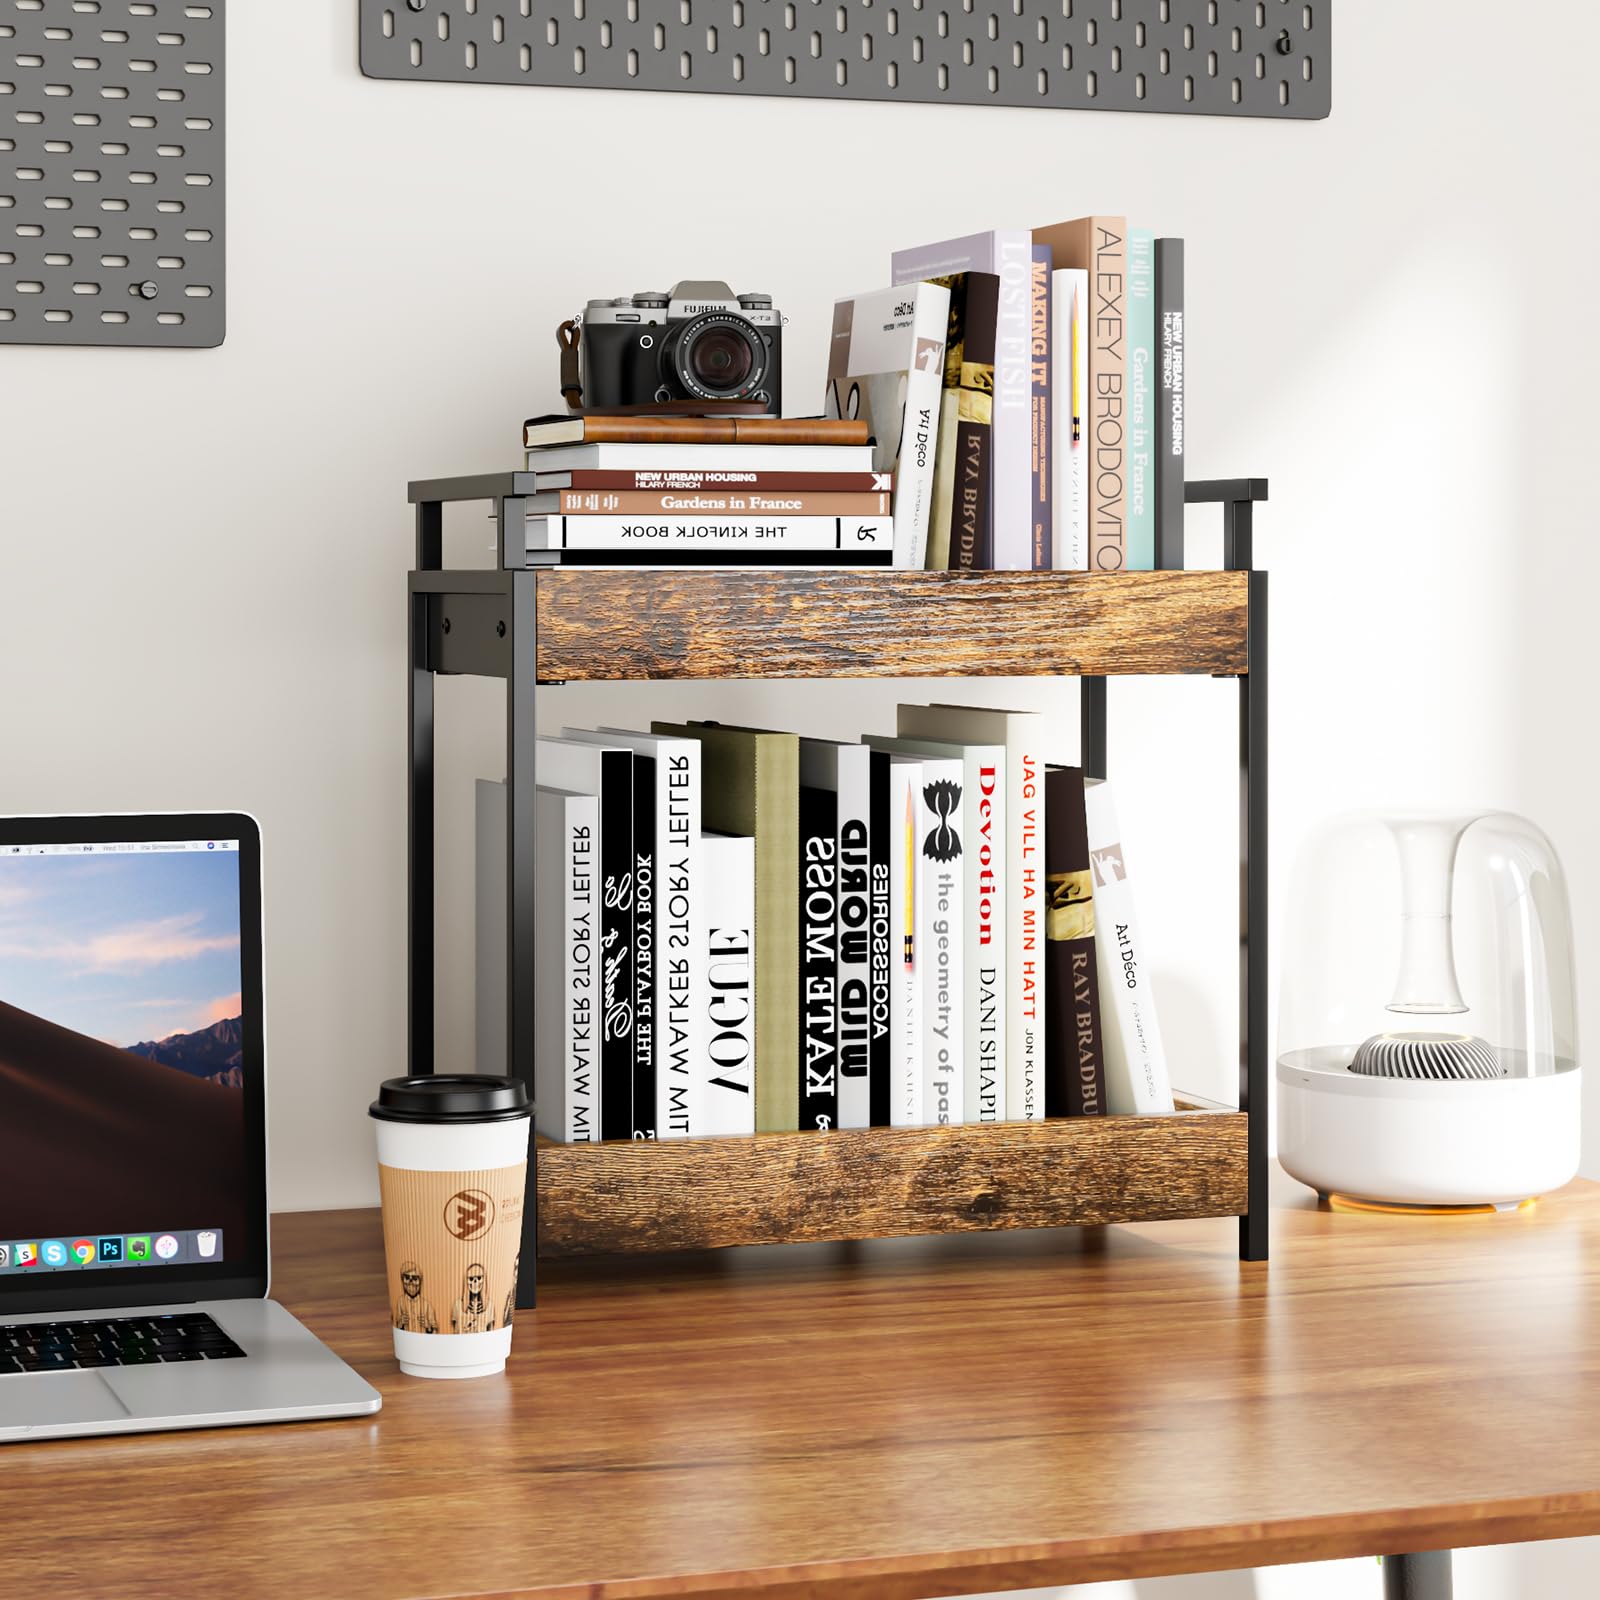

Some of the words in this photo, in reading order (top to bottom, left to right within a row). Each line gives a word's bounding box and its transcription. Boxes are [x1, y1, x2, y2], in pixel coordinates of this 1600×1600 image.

[1001, 241, 1027, 327] LOST
[1096, 226, 1122, 361] ALEXEY
[1032, 261, 1047, 357] MAKING
[1163, 312, 1173, 347] HILARY
[1172, 312, 1183, 341] NEW
[1001, 336, 1027, 410] FISH
[1032, 362, 1047, 386] IT
[1132, 347, 1149, 425] Gardens
[1163, 348, 1173, 389] FRENCH
[1172, 345, 1183, 392] URBAN
[1132, 428, 1149, 444] in
[1172, 394, 1183, 455] HOUSING
[635, 472, 662, 482] NEW
[663, 472, 704, 482] URBAN
[705, 473, 757, 483] HOUSING
[635, 481, 666, 489] HILARY
[666, 481, 701, 489] FRENCH
[1132, 452, 1149, 516] France
[661, 496, 727, 511] Gardens
[729, 496, 745, 511] in
[749, 496, 803, 511] France
[1023, 754, 1035, 799] JAG
[1023, 809, 1035, 859] VILL
[978, 764, 996, 946] Devotion
[937, 873, 954, 912] the
[1023, 868, 1035, 901] HA
[1023, 910, 1035, 951] MIN
[1116, 923, 1131, 947] Art
[933, 919, 952, 1041] geometry
[1072, 951, 1091, 1005] RAY
[1120, 949, 1138, 989] Déco
[979, 967, 996, 1033] DANI
[1023, 960, 1035, 1020] HATT
[937, 1048, 955, 1073] of
[1024, 1028, 1034, 1057] JON
[1024, 1060, 1034, 1121] KLASSEN
[47, 1244, 60, 1262] S
[103, 1243, 118, 1255] Ps
